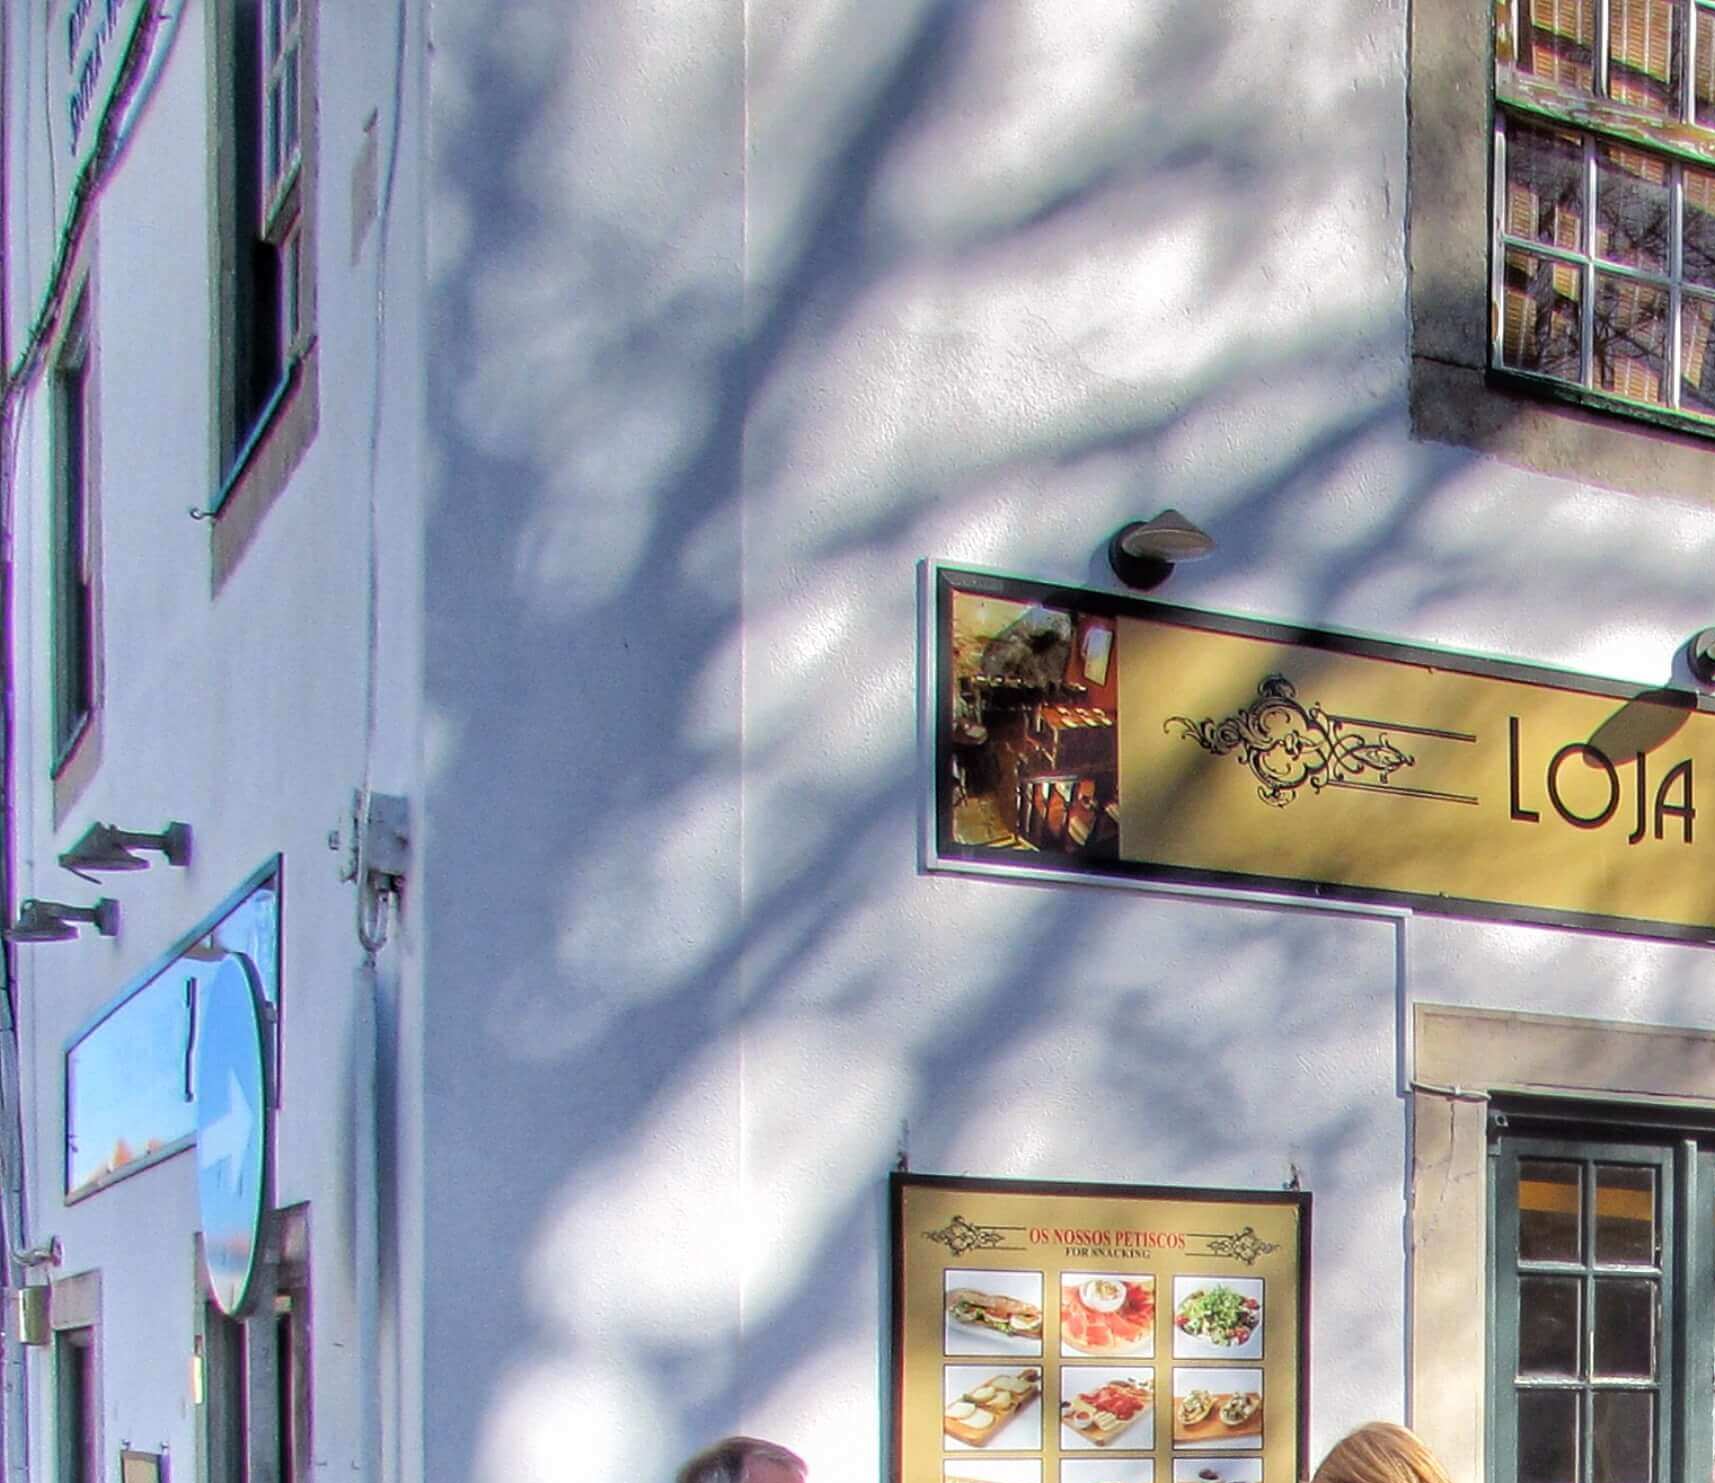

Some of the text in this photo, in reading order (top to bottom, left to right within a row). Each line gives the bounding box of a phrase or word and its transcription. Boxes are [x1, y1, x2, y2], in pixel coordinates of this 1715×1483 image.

[1509, 716, 1696, 845] LOJA
[1029, 1227, 1186, 1249] OS NOSSOS PETISCOS
[1065, 1246, 1152, 1260] FOR SNACKING
